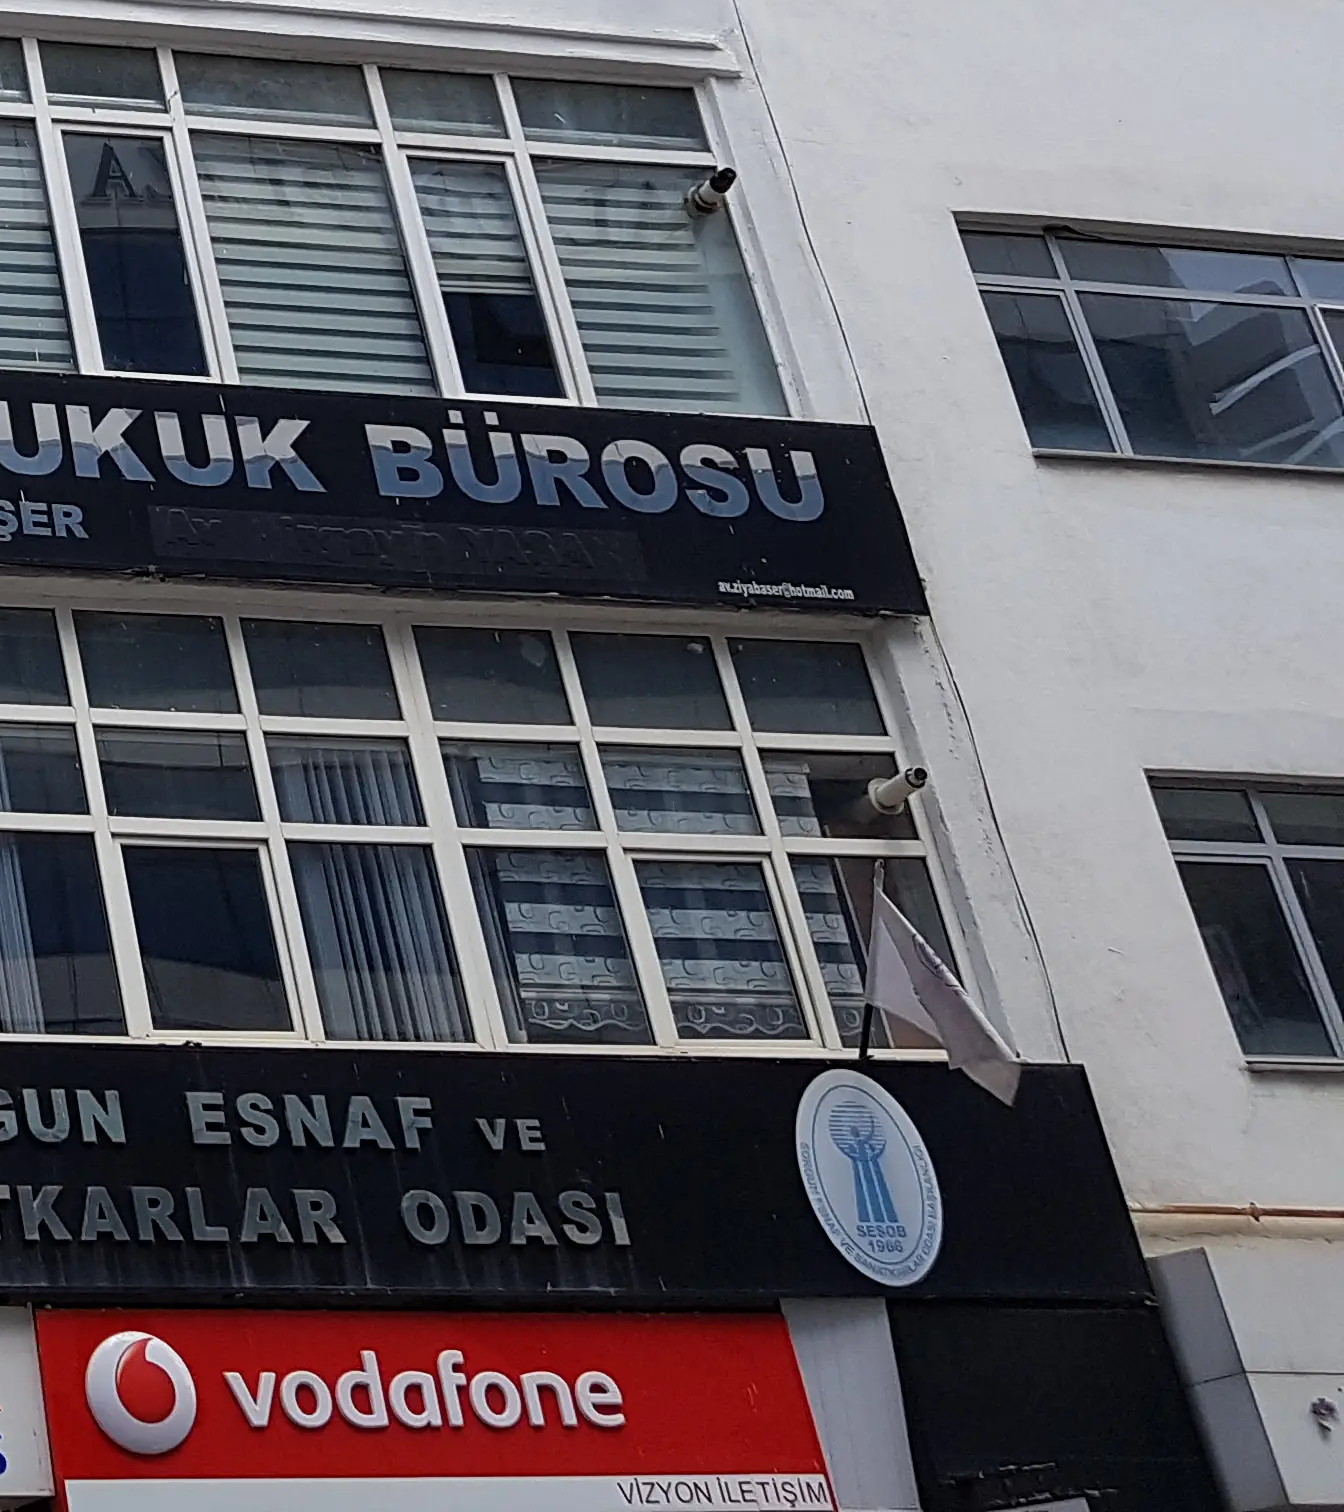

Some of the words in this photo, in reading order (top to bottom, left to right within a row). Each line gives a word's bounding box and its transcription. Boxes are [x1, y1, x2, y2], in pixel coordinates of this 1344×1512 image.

[364, 410, 826, 524] BÜROSU
[185, 1091, 433, 1150] ESNAF
[475, 1118, 546, 1152] VE
[401, 1189, 631, 1247] ODASI
[857, 1225, 907, 1238] SESOB
[223, 1349, 626, 1430] vodafone
[617, 1478, 713, 1504] VİZYON
[716, 1477, 828, 1507] İLETİŞİM
